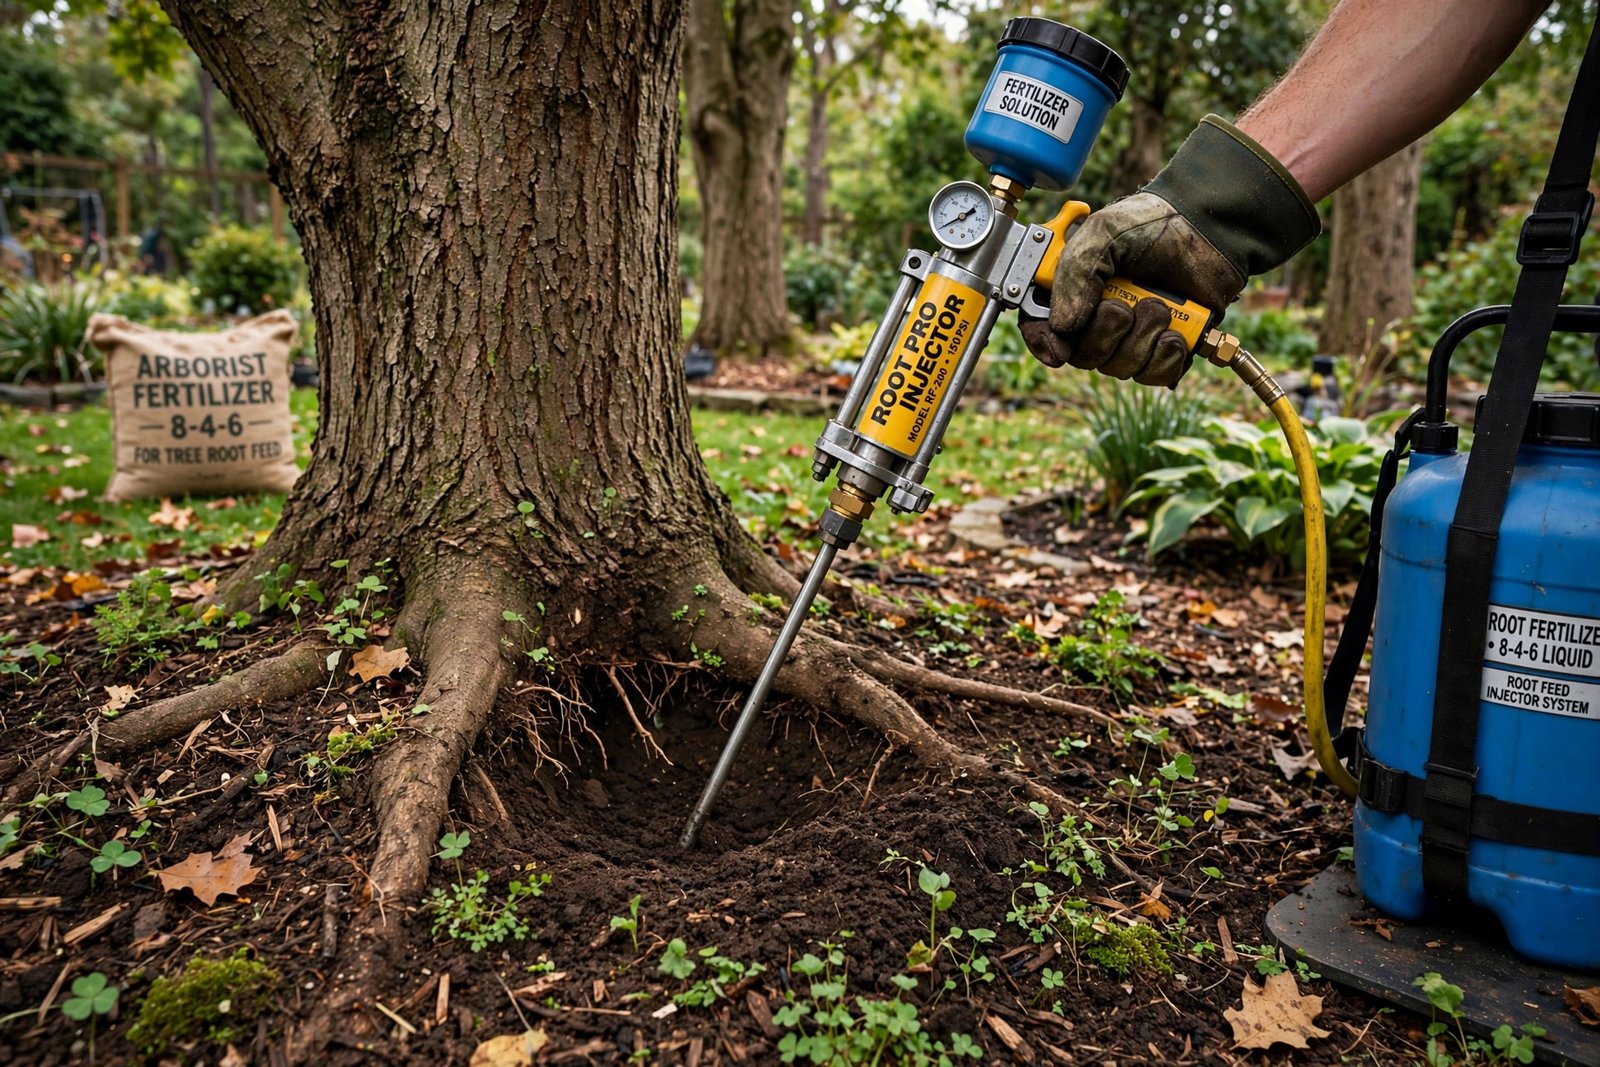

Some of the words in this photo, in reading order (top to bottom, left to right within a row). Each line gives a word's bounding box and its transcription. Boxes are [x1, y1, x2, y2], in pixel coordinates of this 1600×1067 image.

[1003, 78, 1069, 116] FERTILIZER
[999, 95, 1060, 131] SOLUTION
[137, 353, 266, 379] ARBORIST
[870, 354, 912, 426] ROOT
[903, 301, 937, 354] PRO
[898, 294, 965, 412] INJECTOR
[133, 380, 275, 409] FERTILIZER
[907, 406, 930, 443] MODEL
[924, 367, 948, 405] RF-200
[947, 337, 961, 355] 150
[956, 319, 970, 338] PSI
[170, 412, 244, 440] 8-4-6
[134, 447, 161, 464] FOR
[166, 446, 204, 464] TREE
[207, 445, 247, 463] ROOT
[251, 441, 282, 460] FEED
[1488, 611, 1526, 636] ROOT
[1529, 618, 1600, 646] FERTILIZE
[1499, 638, 1538, 661] 8-4-6
[1542, 643, 1593, 669] LIQUID
[1486, 686, 1540, 708] INJECTOR
[1542, 696, 1590, 715] SYSTEM
[1507, 675, 1538, 692] ROOT
[1541, 680, 1570, 697] FEED
